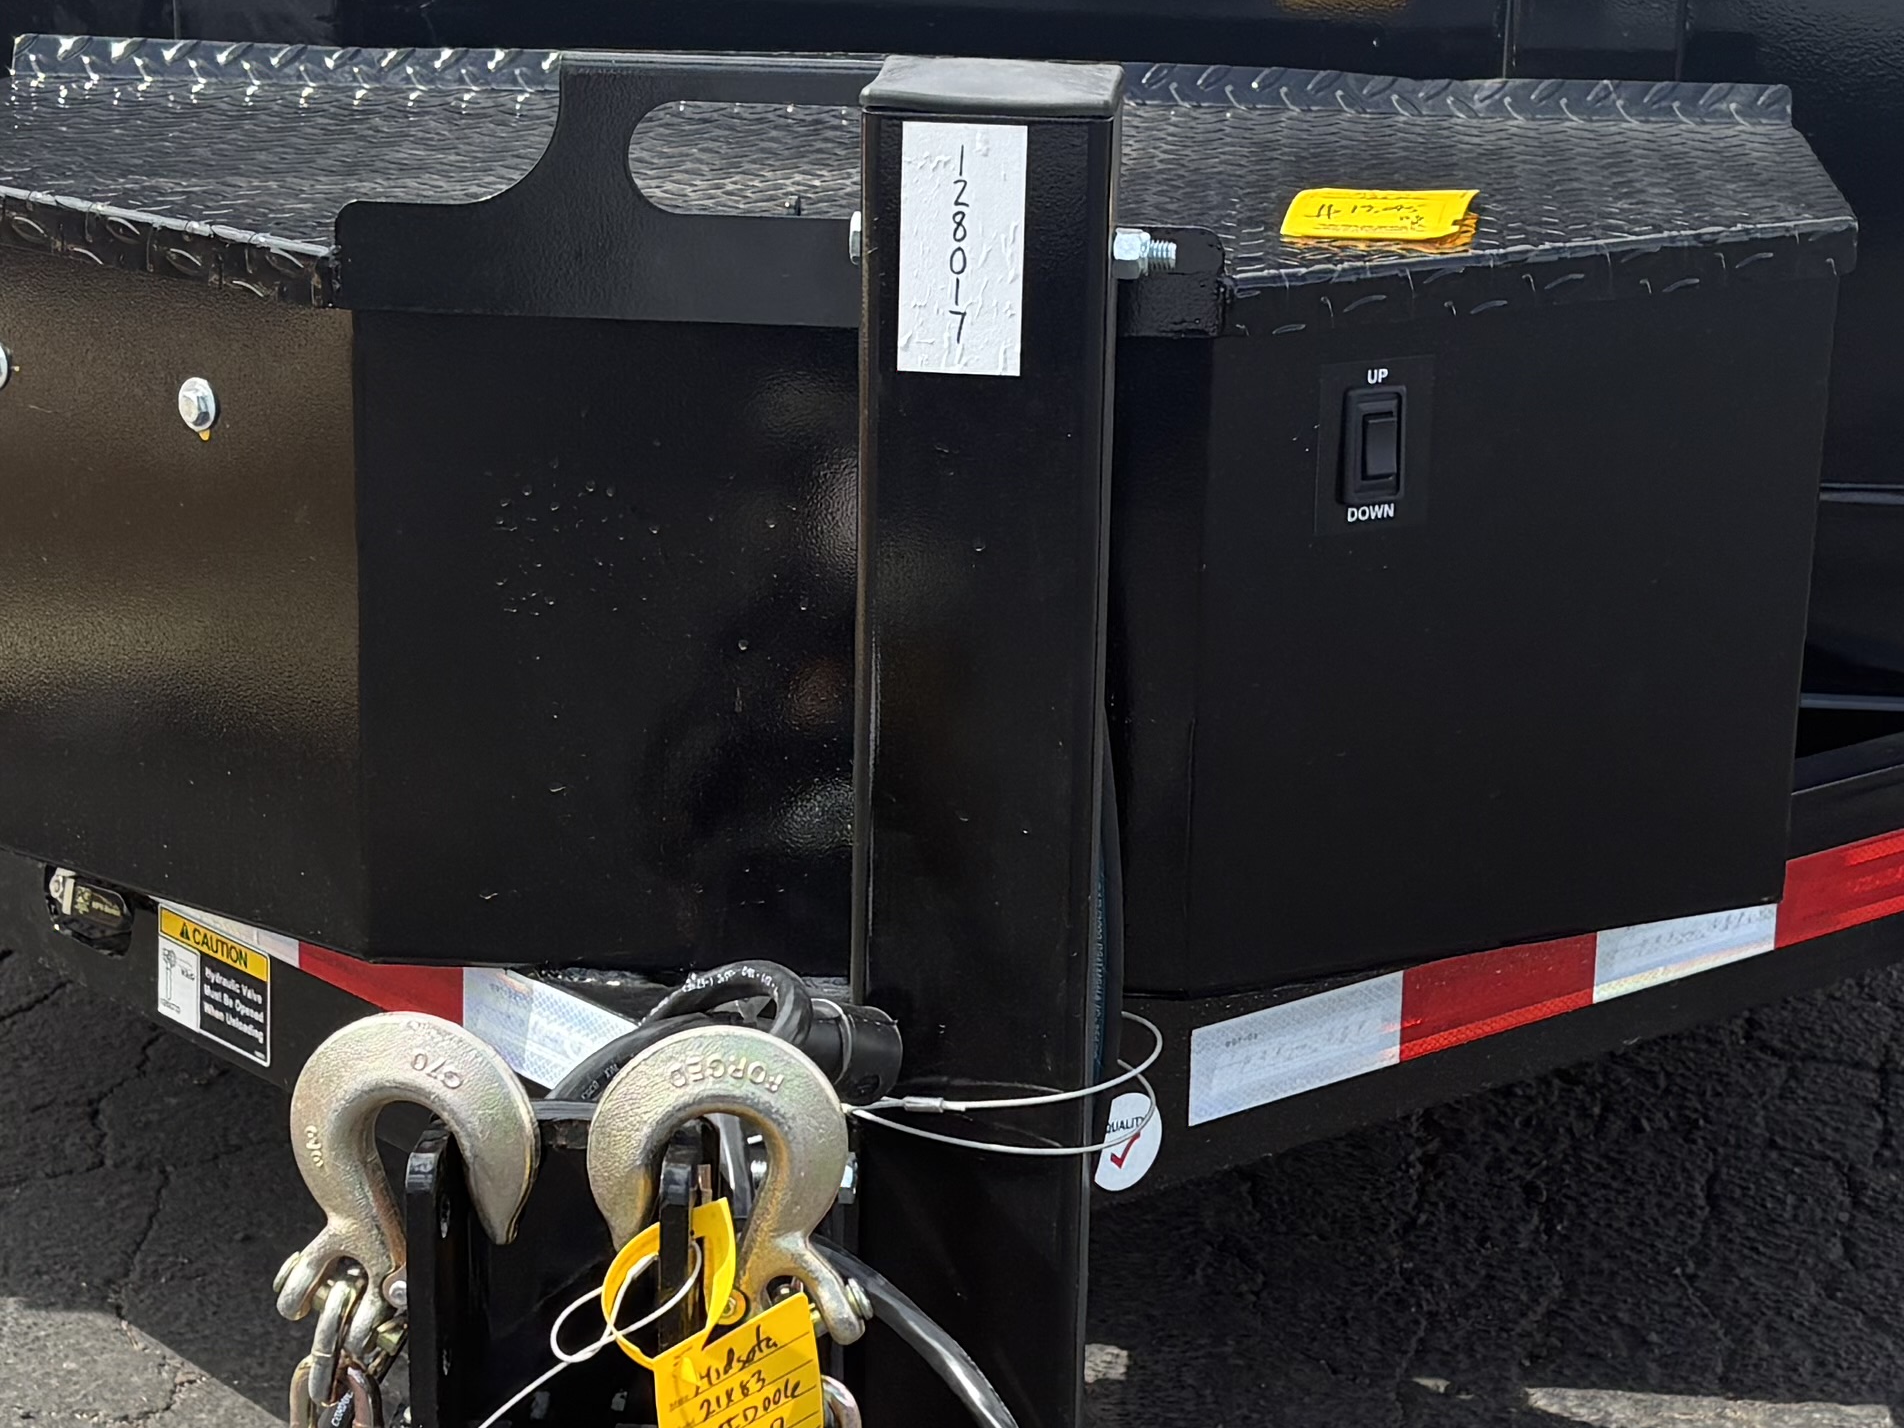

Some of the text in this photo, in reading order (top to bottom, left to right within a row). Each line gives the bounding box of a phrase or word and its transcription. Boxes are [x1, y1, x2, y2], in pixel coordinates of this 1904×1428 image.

[1367, 368, 1389, 384] UP
[1346, 502, 1395, 523] DOWN
[192, 927, 248, 969] CAUTION
[669, 1055, 785, 1093] FORGED
